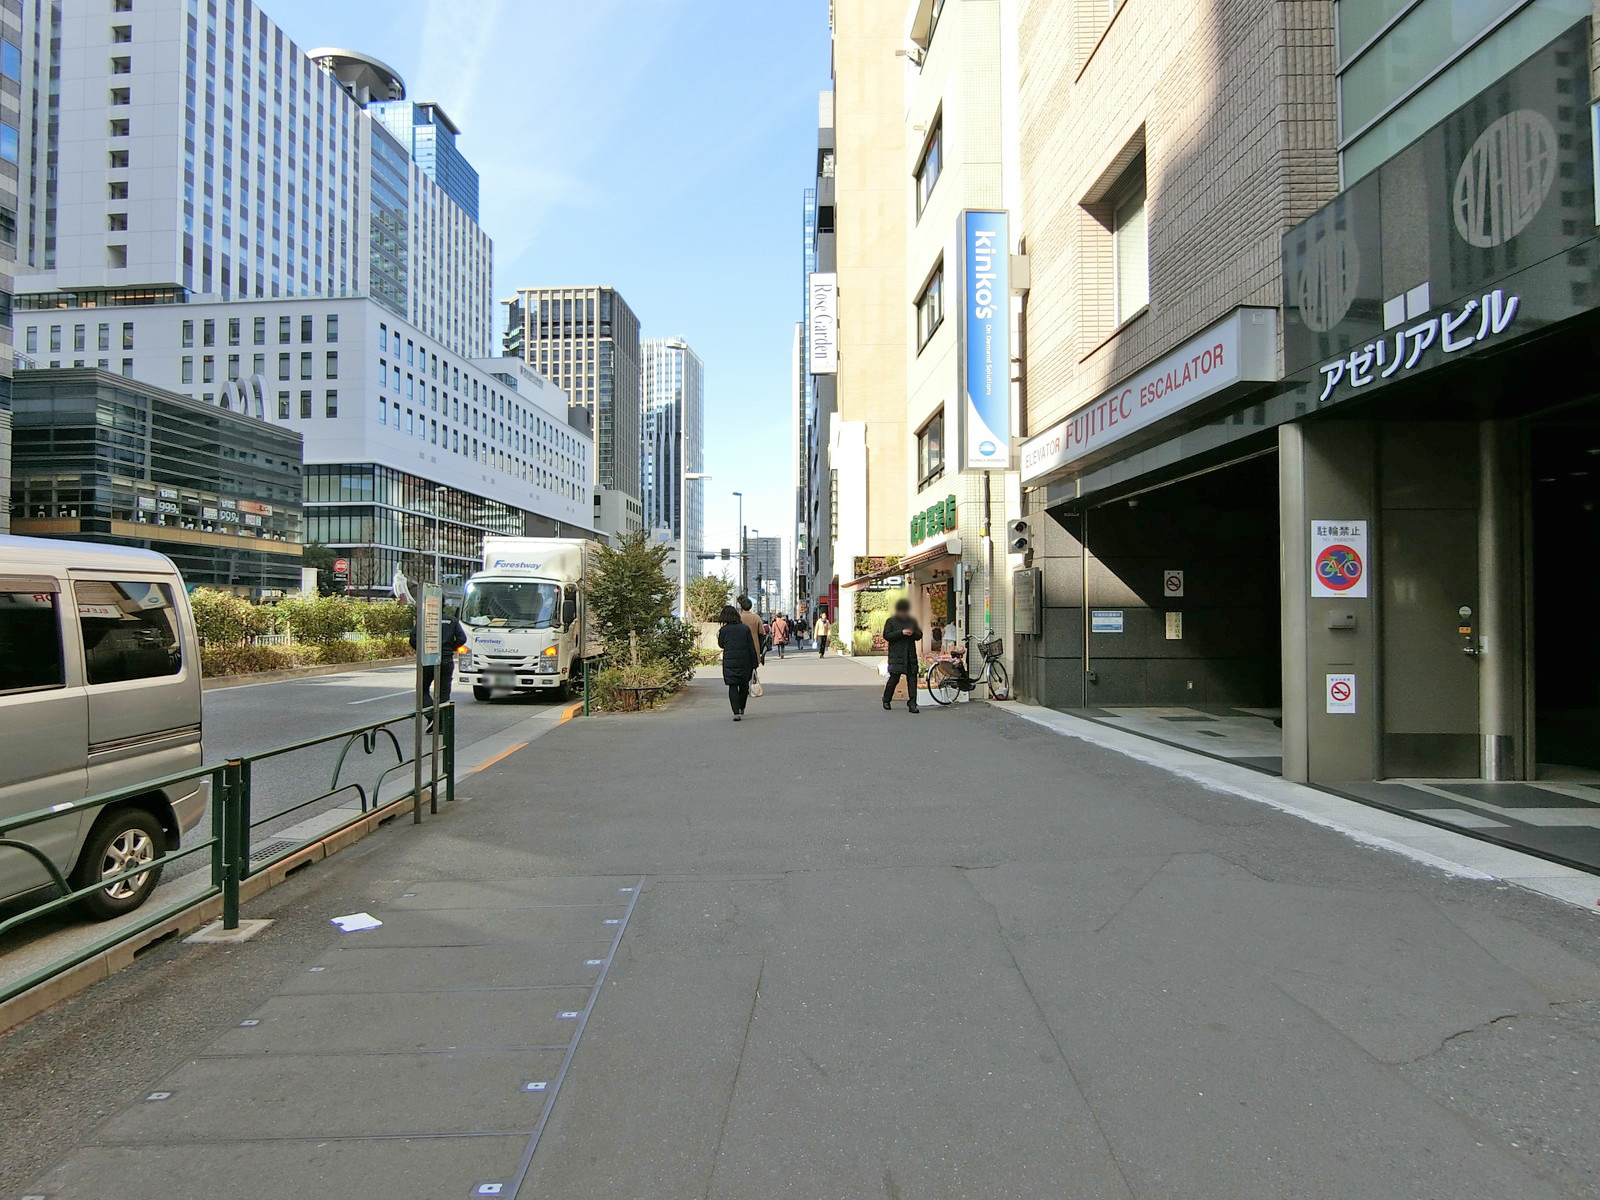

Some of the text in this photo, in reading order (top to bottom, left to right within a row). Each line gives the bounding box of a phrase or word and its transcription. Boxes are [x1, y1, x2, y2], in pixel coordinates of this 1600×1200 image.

[814, 284, 833, 311] Rose
[814, 314, 833, 359] Garden
[985, 324, 992, 334] On
[1319, 288, 1521, 402] アゼリアビル
[1024, 342, 1225, 469] ELEVATOR FUJITEC ESCALATOR
[1317, 525, 1361, 537] 駐輪禁止
[493, 559, 542, 571] Forestway
[474, 636, 502, 645] Forestway
